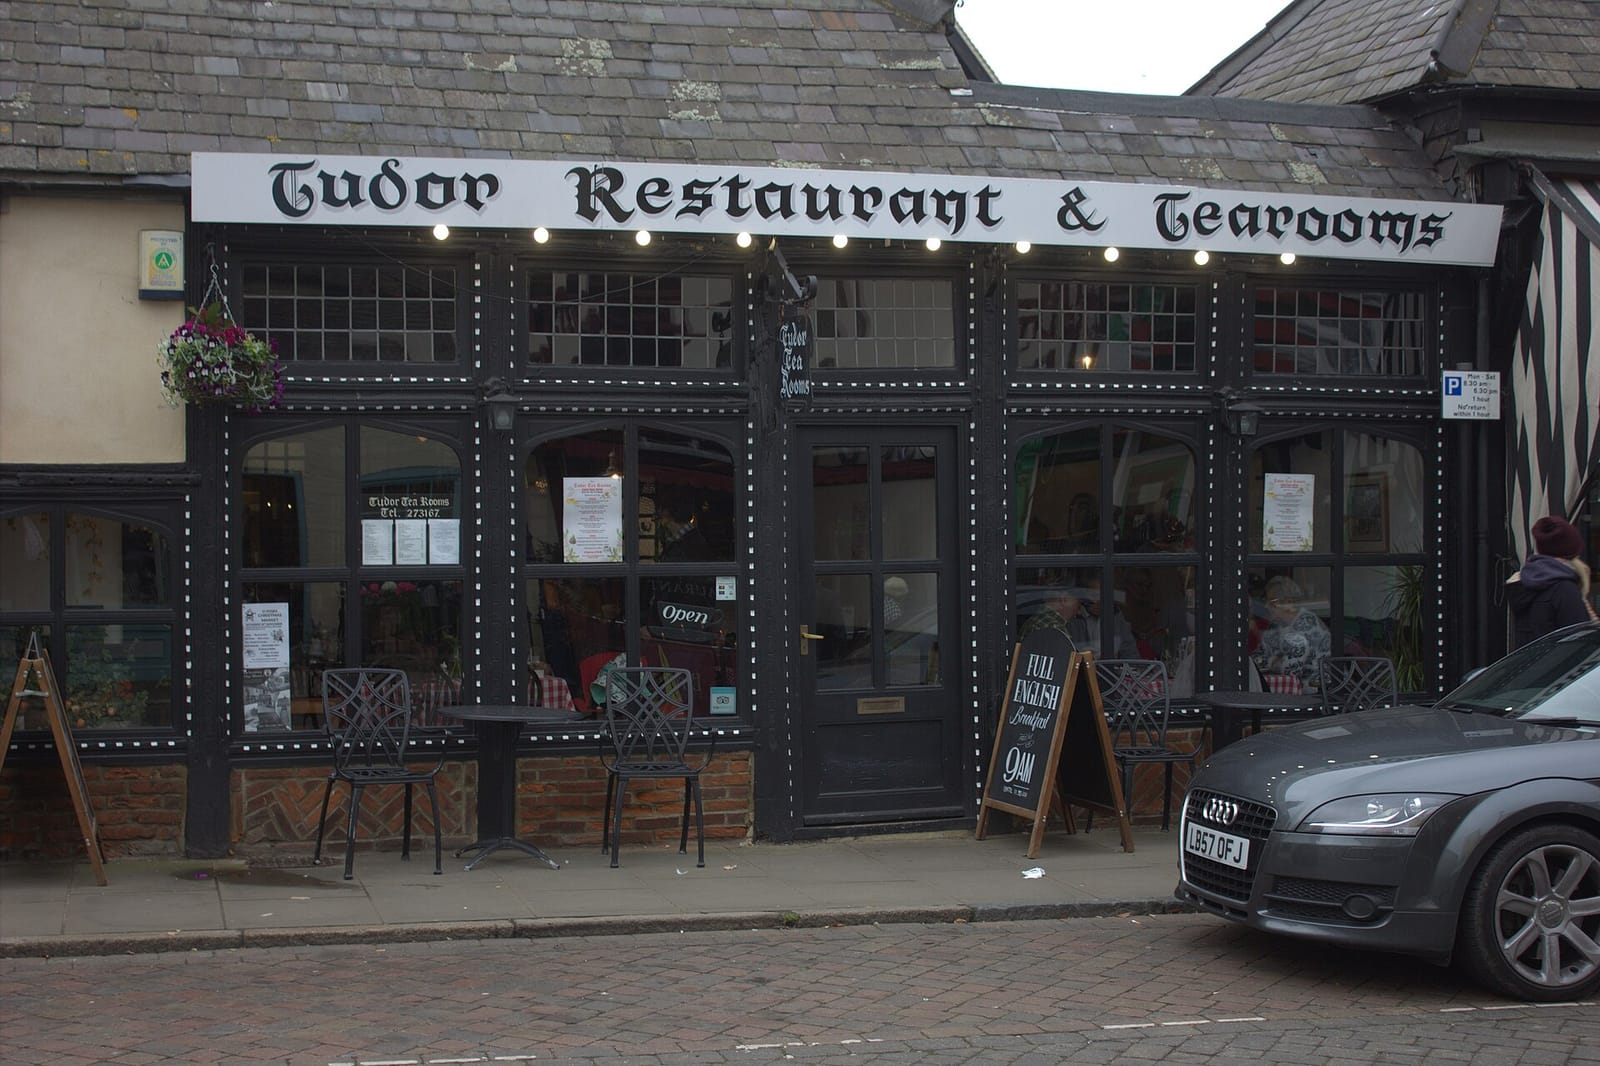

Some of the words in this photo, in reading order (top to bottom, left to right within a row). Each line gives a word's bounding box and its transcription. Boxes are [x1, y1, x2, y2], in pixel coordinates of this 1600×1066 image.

[268, 158, 499, 217] Tudor
[564, 164, 1003, 235] Restaurant
[1056, 186, 1106, 232] &
[1153, 192, 1453, 254] Tearooms
[780, 322, 807, 347] Tudor
[782, 346, 803, 371] Tea
[780, 365, 810, 398] Rooms
[368, 496, 400, 507] Tudor
[401, 496, 418, 507] Tea
[419, 496, 450, 507] Rooms
[380, 508, 401, 518] Tel.
[662, 604, 708, 625] Open
[1026, 653, 1055, 681] FULL
[1013, 678, 1061, 711] ENGLISH
[1009, 705, 1052, 732] Breakfast
[1003, 746, 1036, 785] 9AM
[1189, 827, 1216, 856] LB57
[1217, 836, 1243, 864] OFJ
